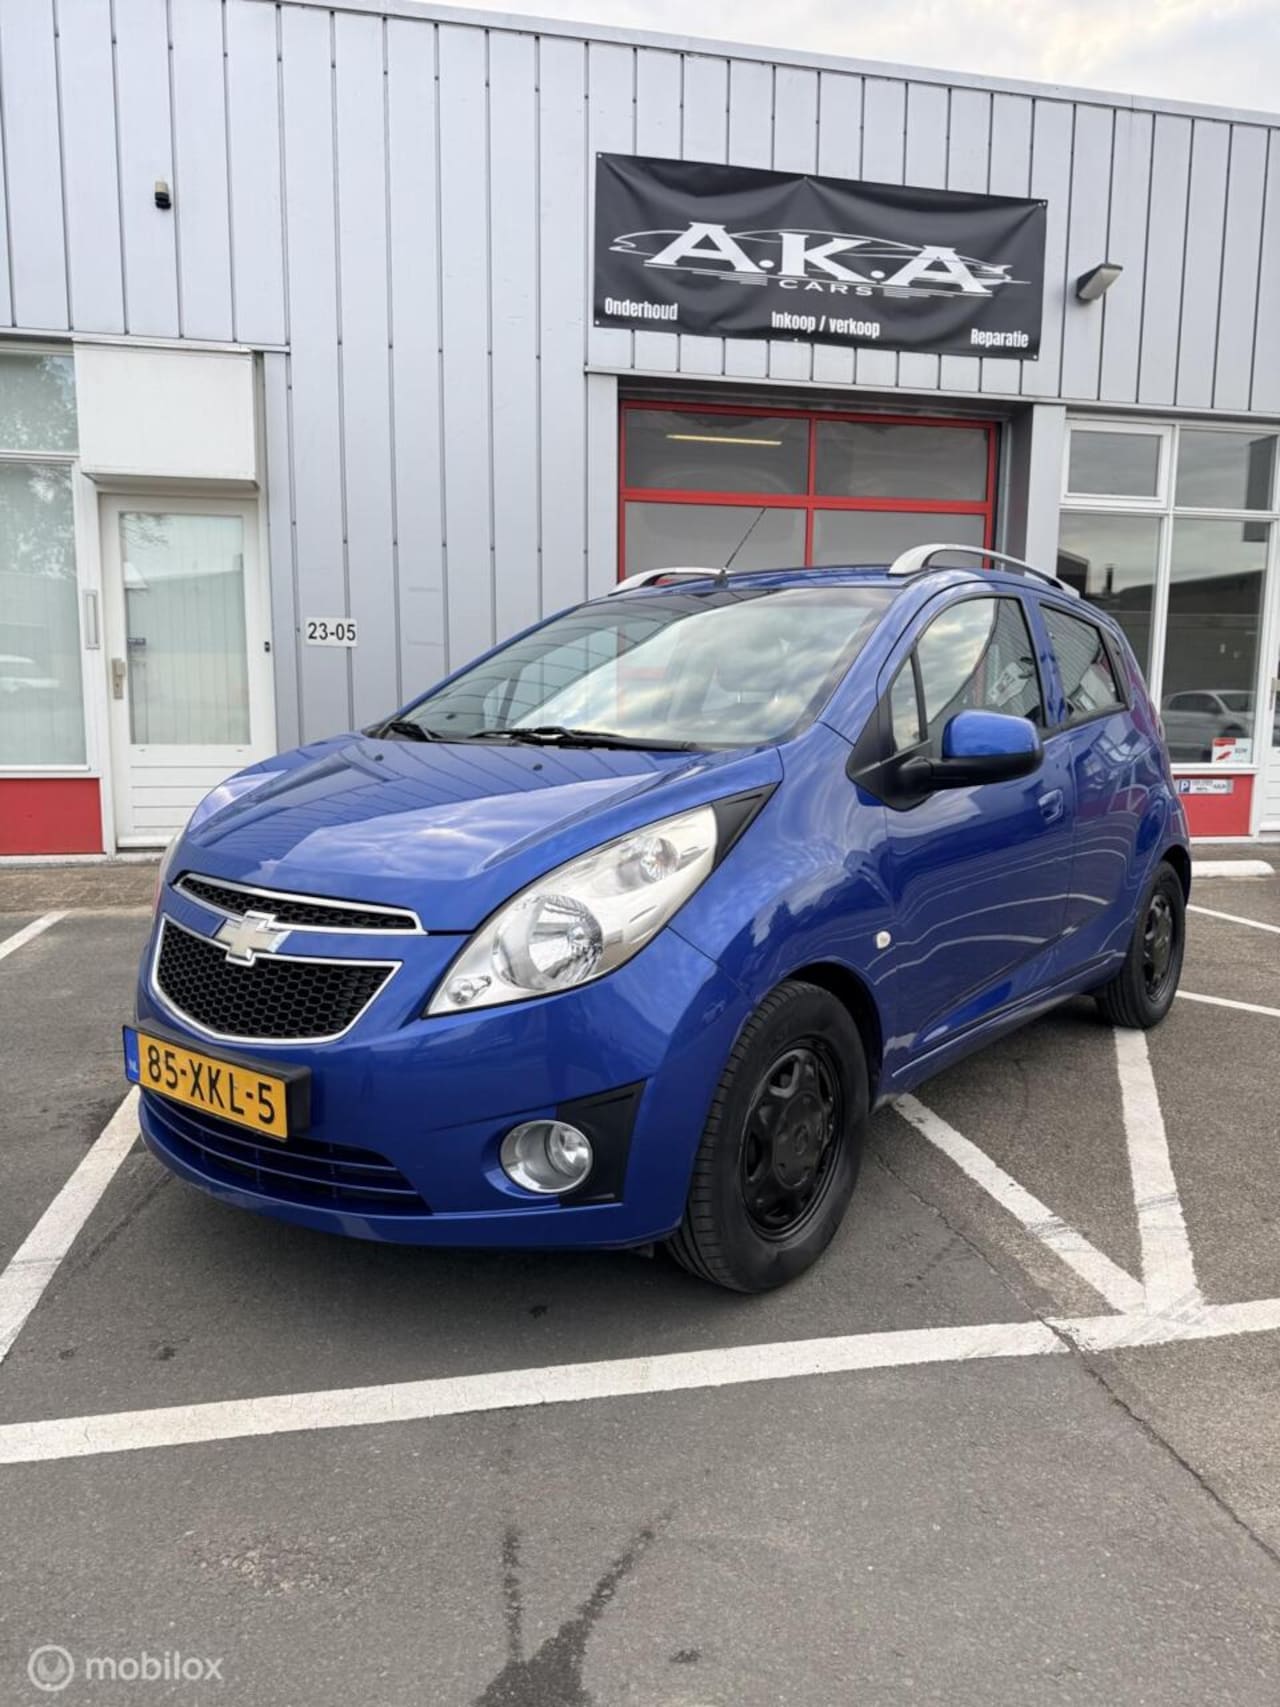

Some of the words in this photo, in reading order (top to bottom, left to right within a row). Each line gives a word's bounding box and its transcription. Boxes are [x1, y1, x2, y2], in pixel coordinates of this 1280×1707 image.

[779, 279, 873, 296] CARS
[605, 297, 678, 320] Onderhoud
[772, 311, 816, 333] Inkoop
[819, 315, 826, 332] /
[829, 317, 880, 339] verkoop
[971, 328, 1029, 348] Reparatie
[308, 622, 356, 641] 23-05
[147, 1044, 275, 1125] 85-XKL-5
